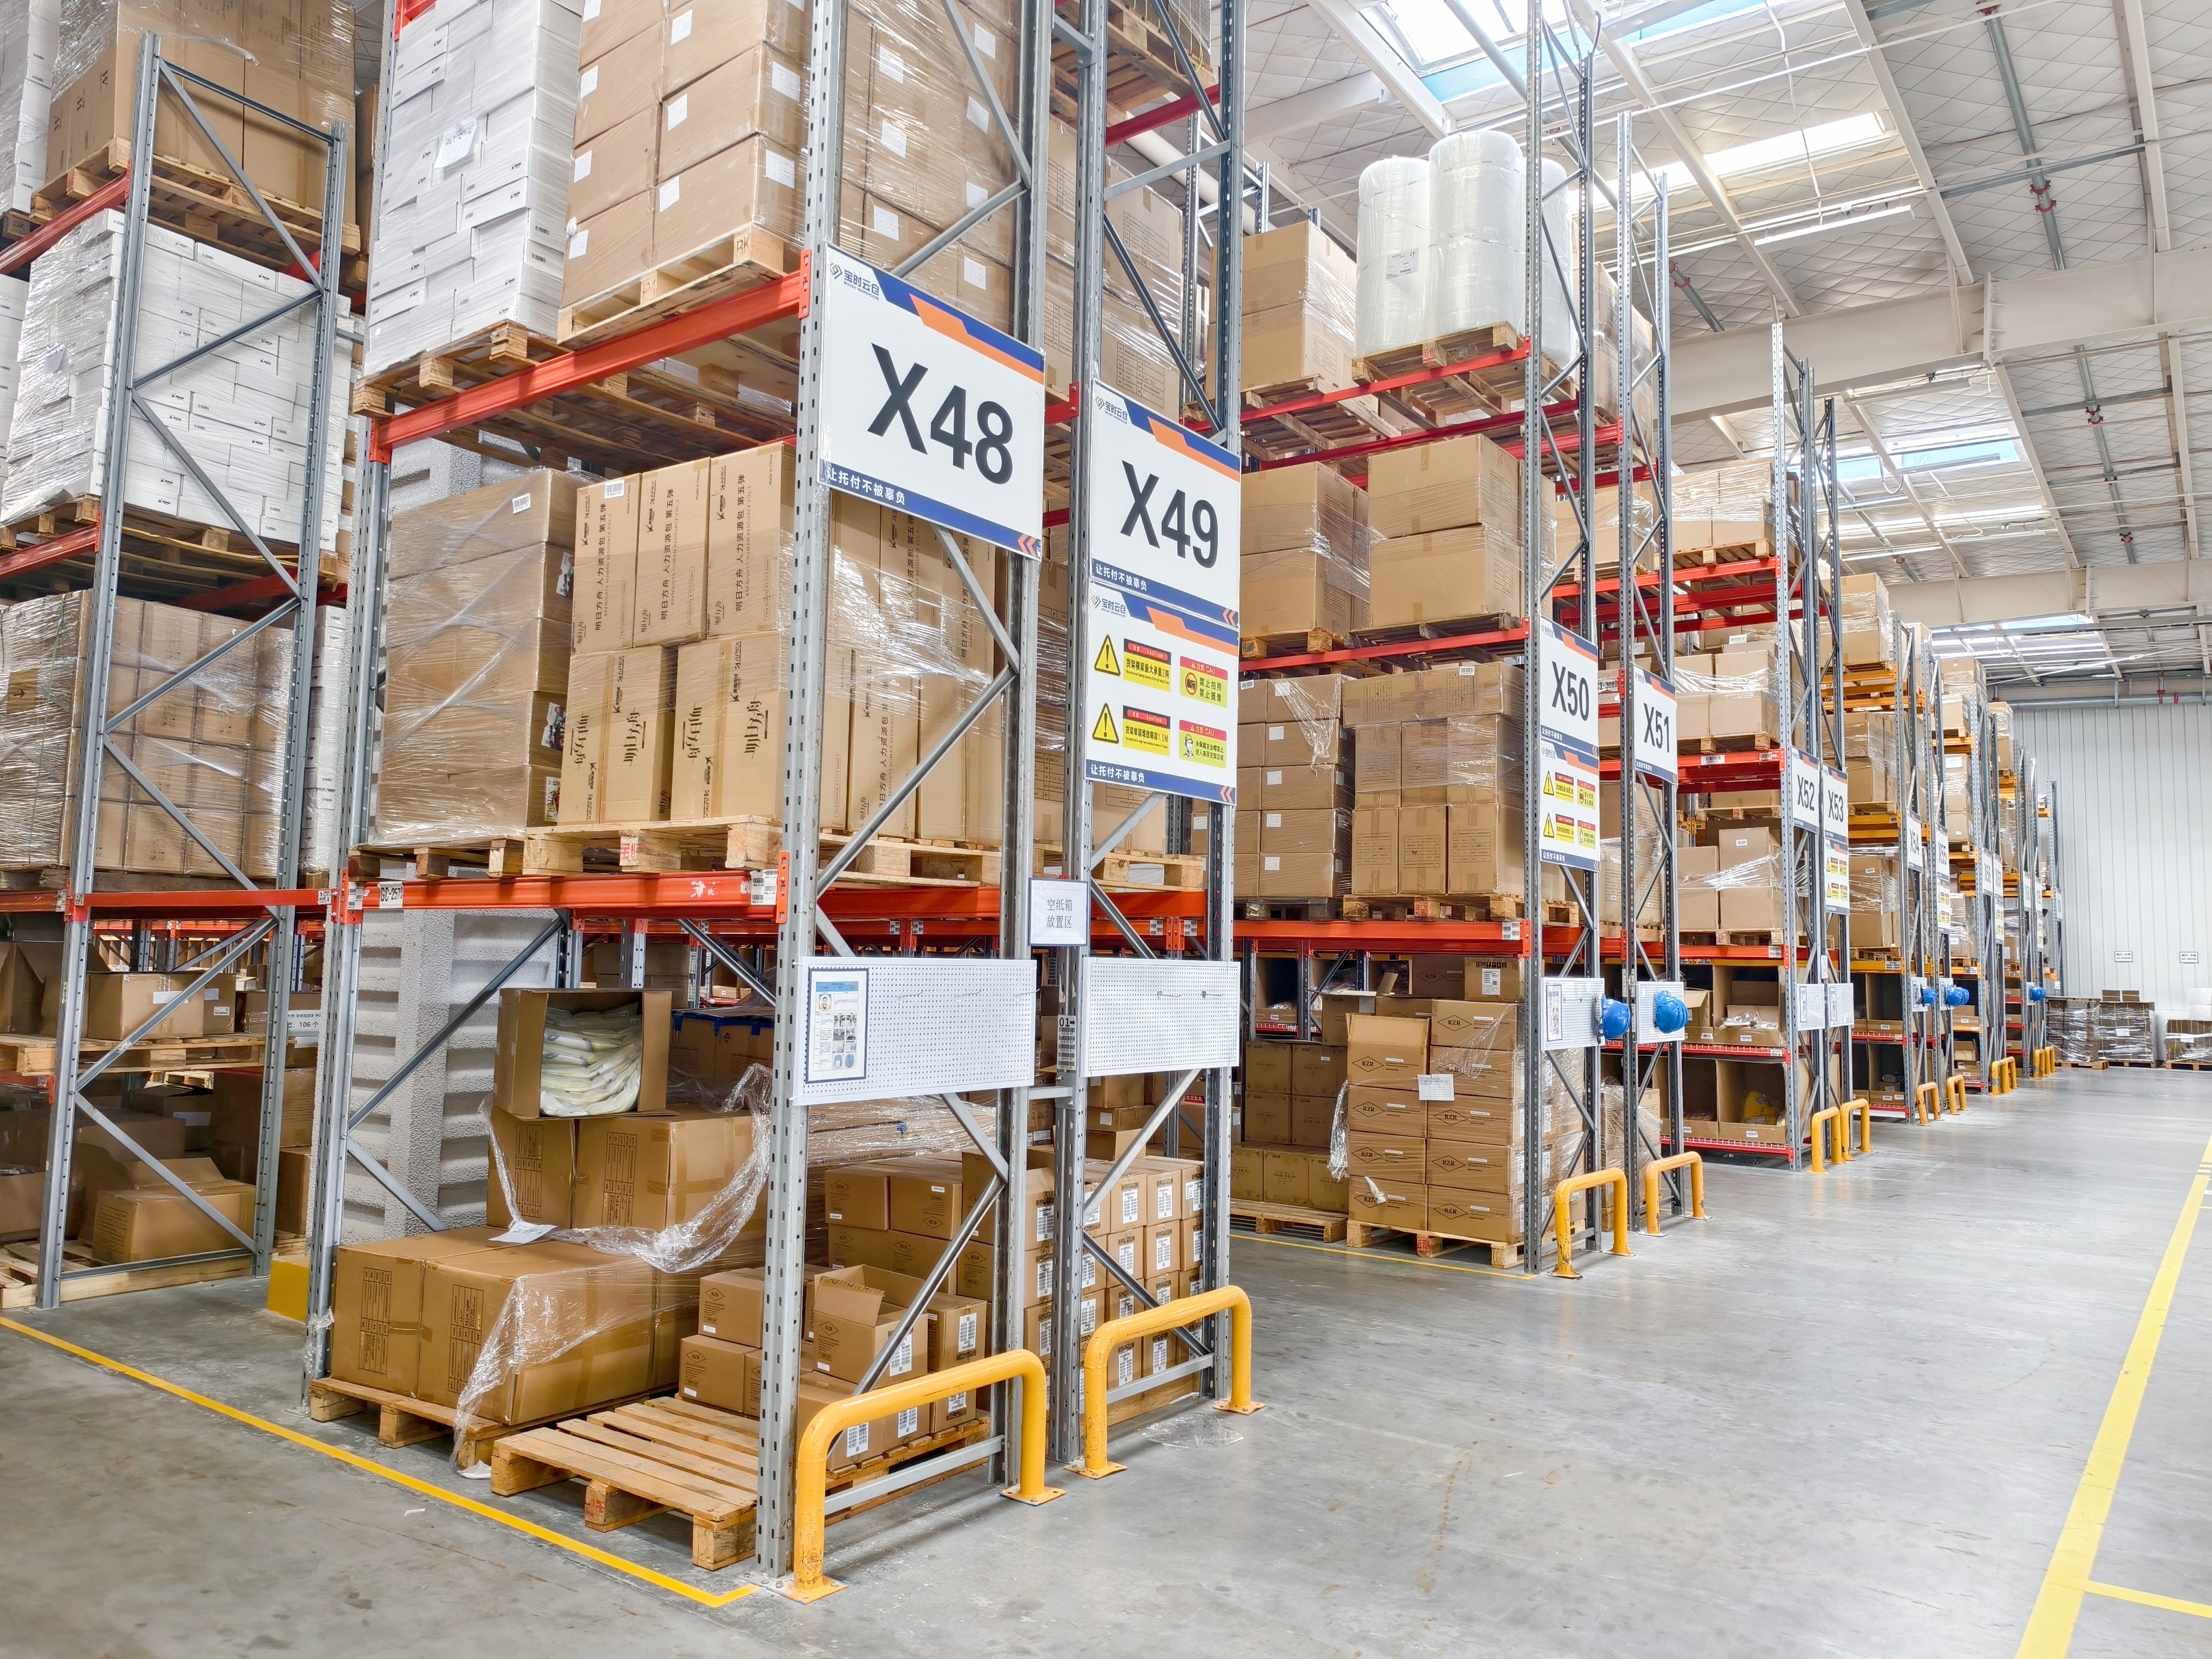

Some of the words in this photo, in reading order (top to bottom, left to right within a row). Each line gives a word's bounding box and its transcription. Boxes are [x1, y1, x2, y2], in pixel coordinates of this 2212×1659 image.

[844, 269, 879, 296] 宝时云仓
[858, 287, 879, 300] WAREHOUSE
[867, 342, 1014, 484] X48
[1105, 401, 1128, 421] 宝时云仓
[737, 474, 745, 506] 第五弹
[827, 468, 905, 505] 让托付不被辜负
[666, 489, 674, 519] 第五弹
[1121, 460, 1218, 569] X49
[663, 523, 672, 574] 人力资源包
[736, 510, 744, 563] 人力资源包
[597, 537, 605, 586] 人力资源包
[735, 569, 744, 611] 明日方舟
[1096, 563, 1147, 591] 让托付不被辜负
[595, 591, 603, 631] 明日方舟
[661, 579, 669, 620] 明日方舟
[1102, 598, 1126, 614] 宝时云仓
[1147, 650, 1163, 658] CAUTION
[1199, 677, 1222, 692] 禁止拍照
[1206, 666, 1216, 675] CAU
[1552, 660, 1589, 721] X50
[1146, 715, 1162, 723] CAUTION
[1205, 728, 1215, 736] CAU
[1643, 703, 1669, 753] X51
[880, 717, 888, 767] 人力资源包
[1091, 764, 1145, 783] 让托付不被辜负
[1797, 774, 1815, 811] X52
[1828, 790, 1844, 822] X53
[1910, 829, 1920, 856] X54
[1938, 841, 1947, 865] X55
[1047, 898, 1073, 912] 空纸箱
[1046, 915, 1073, 928] 放置区
[1059, 1017, 1070, 1027] 01
